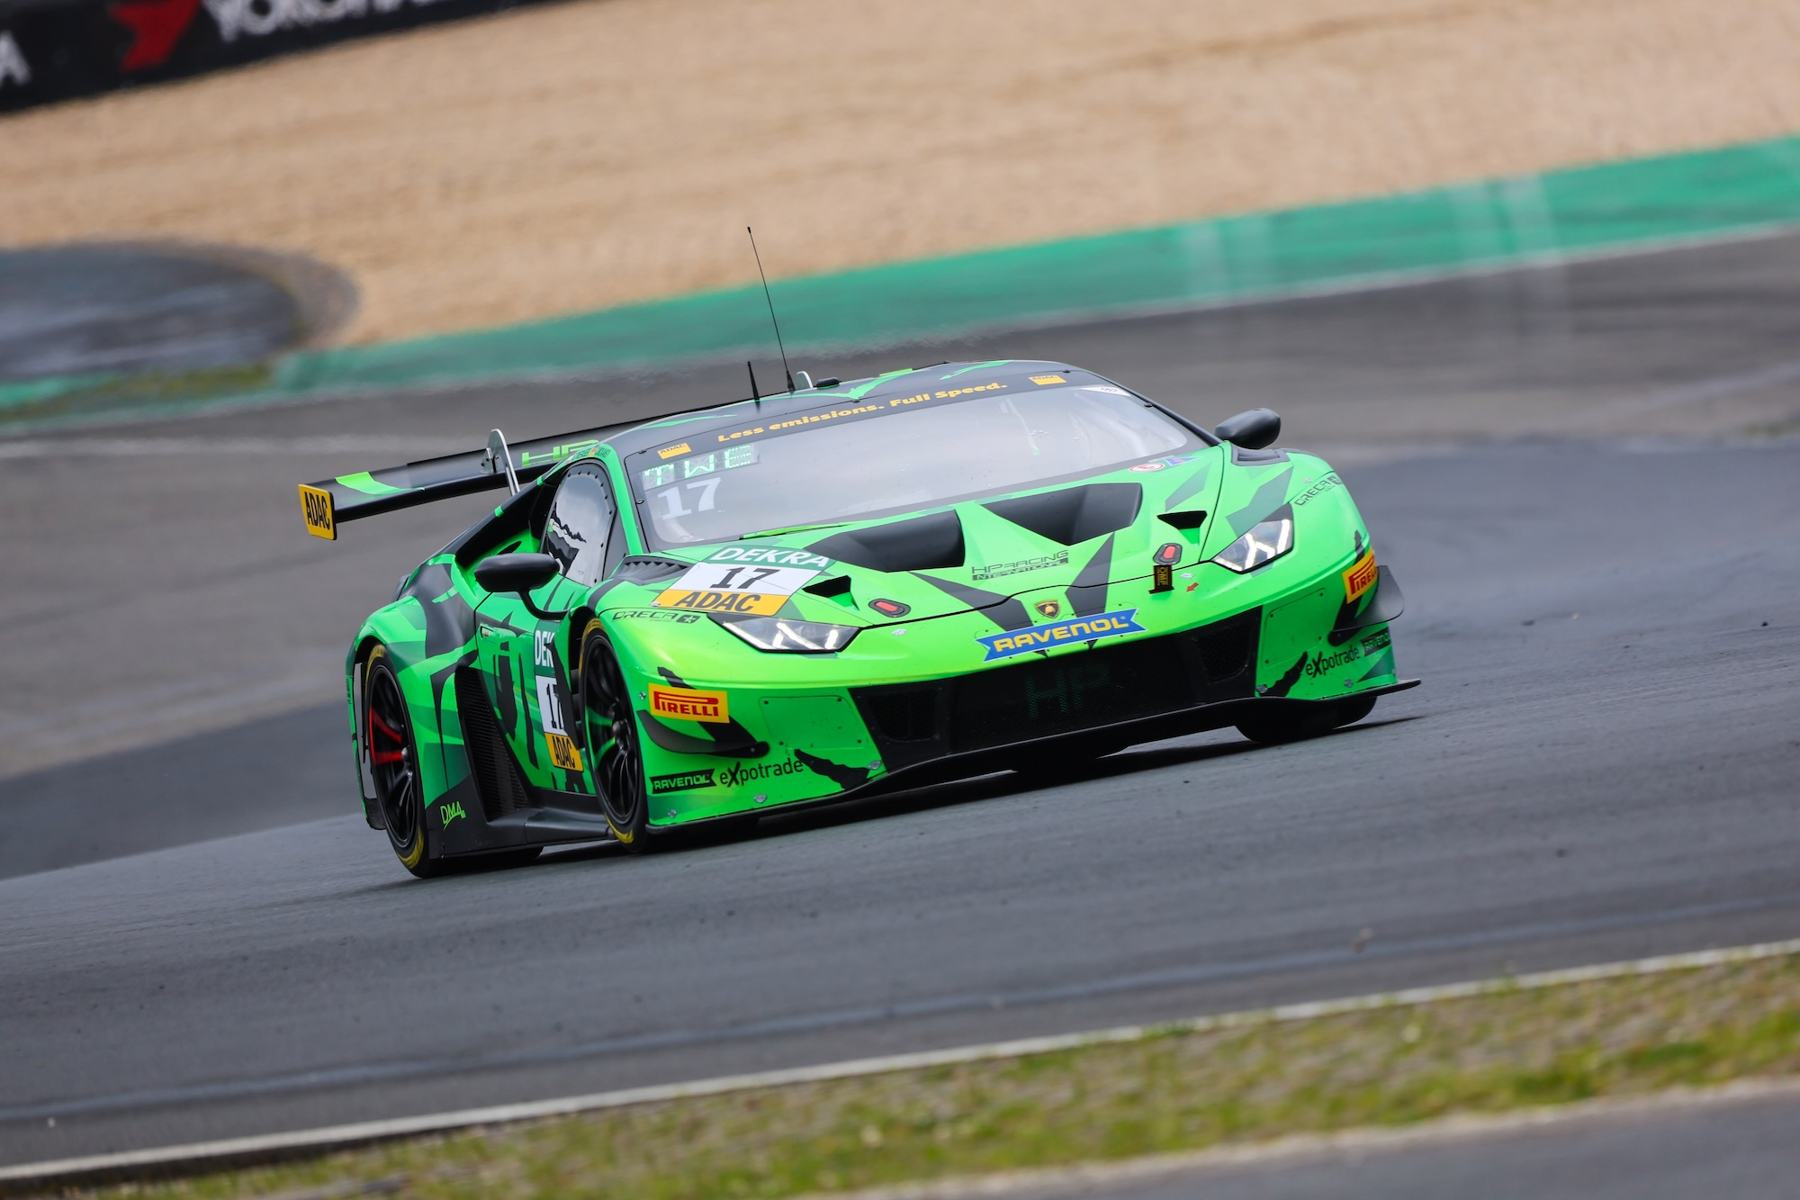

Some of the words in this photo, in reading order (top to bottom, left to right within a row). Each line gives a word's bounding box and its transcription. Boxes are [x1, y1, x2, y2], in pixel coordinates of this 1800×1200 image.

[718, 427, 764, 442] Less
[769, 404, 884, 431] emissions.
[890, 393, 931, 408] Full
[935, 382, 1008, 399] Speed.
[304, 491, 330, 530] ADAC
[658, 477, 721, 520] 17
[710, 548, 829, 568] DEKRA
[709, 567, 780, 590] 17
[674, 592, 762, 612] ADAC
[535, 630, 556, 668] DEK
[993, 618, 1129, 653] RAVENOL
[654, 691, 720, 717] PIRELLI
[552, 736, 575, 769] ADAC
[654, 773, 710, 790] RAVENOL
